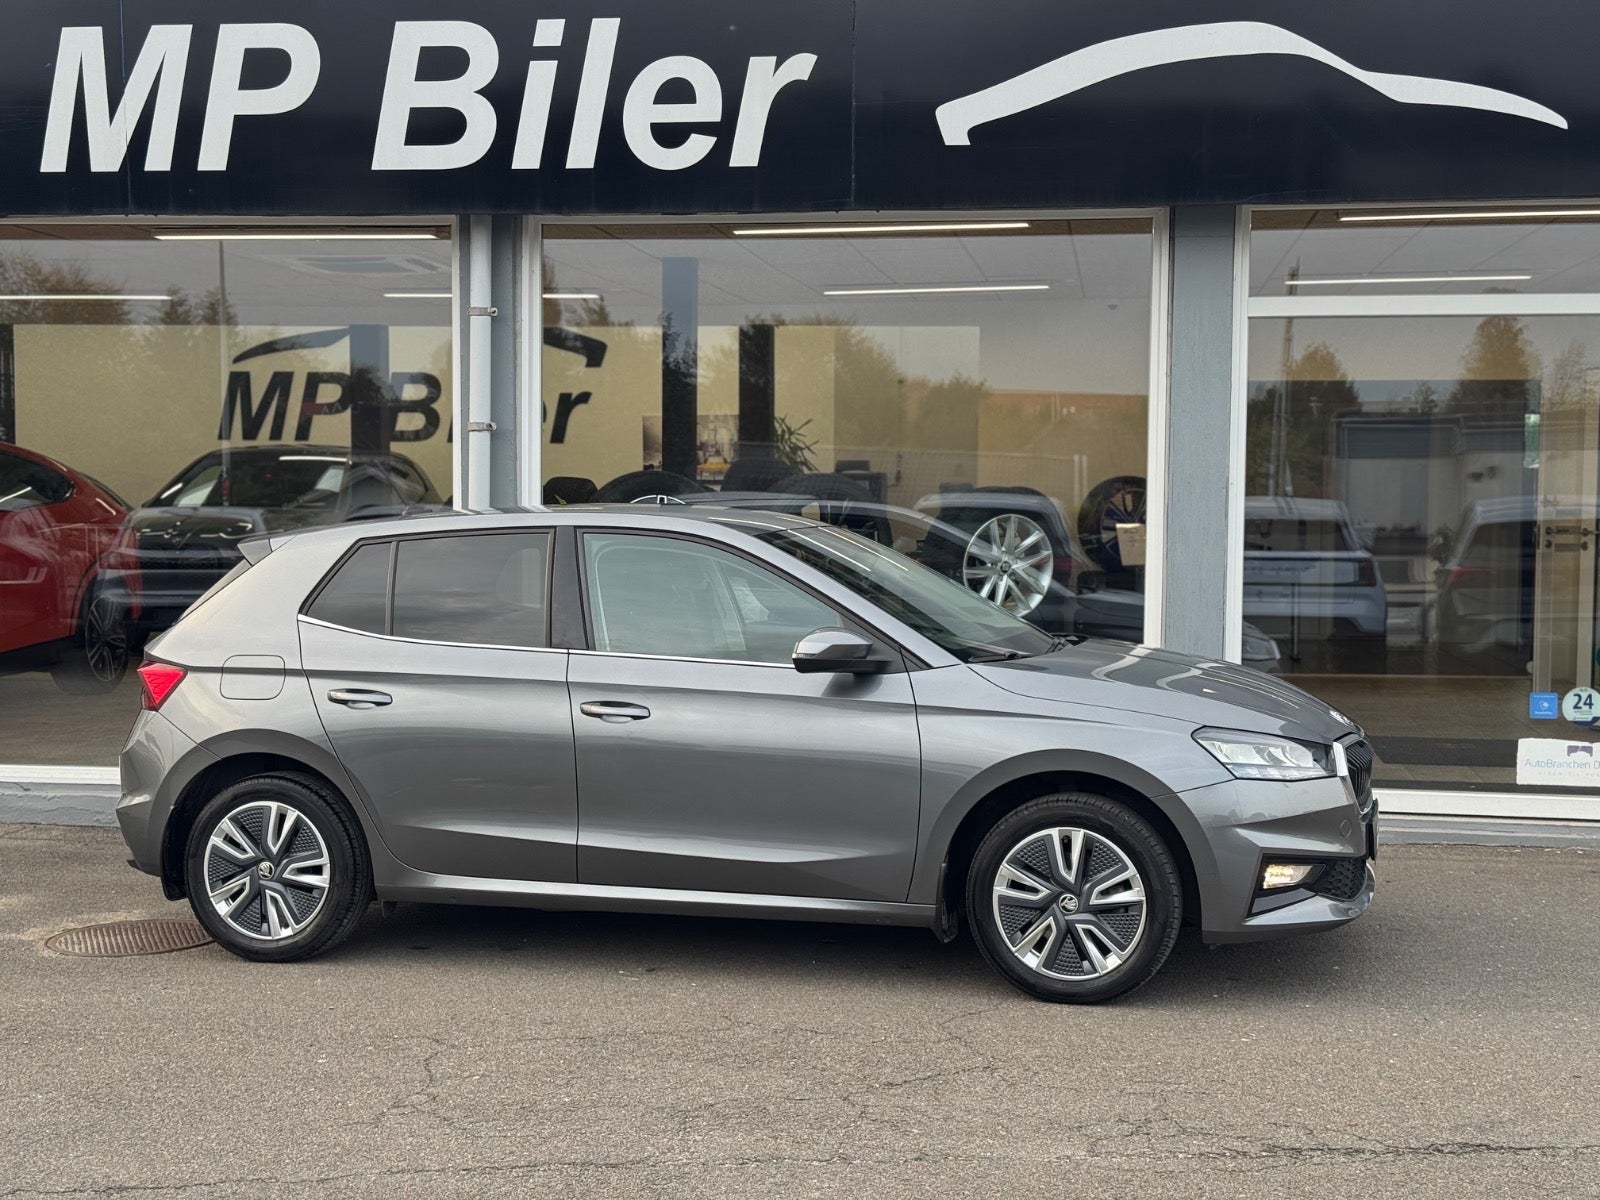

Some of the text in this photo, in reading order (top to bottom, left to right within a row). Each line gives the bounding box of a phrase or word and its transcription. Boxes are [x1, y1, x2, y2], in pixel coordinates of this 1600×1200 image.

[39, 17, 818, 173] MP Biler
[217, 371, 352, 442] MP
[1572, 693, 1593, 709] 24
[1524, 758, 1591, 769] AutoBranchen
